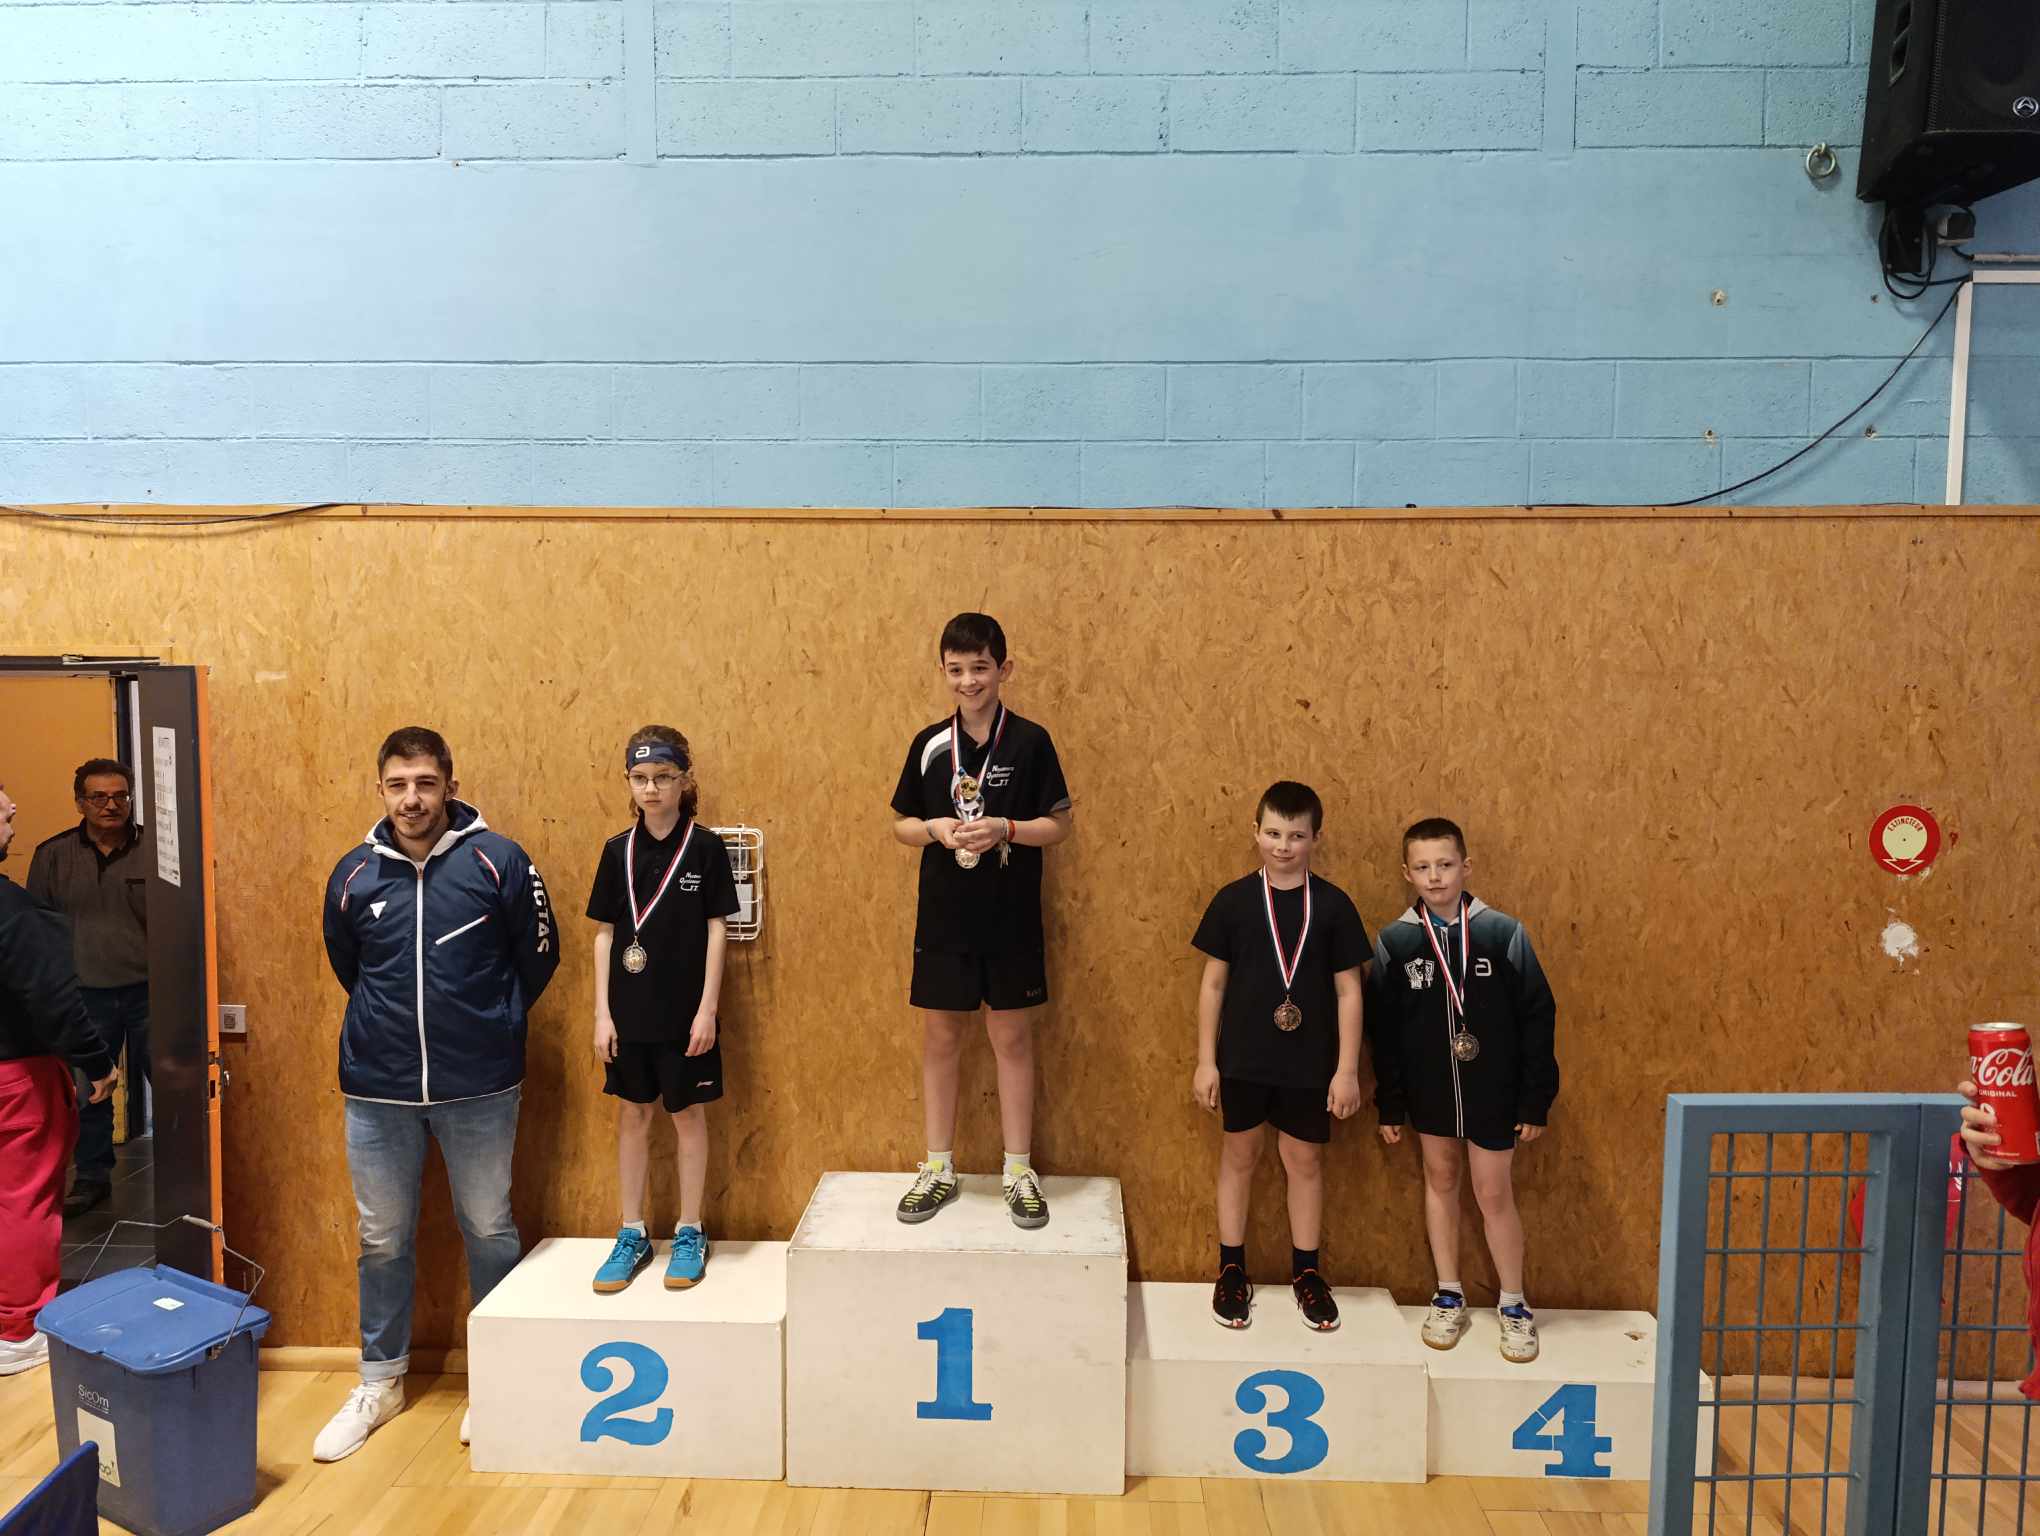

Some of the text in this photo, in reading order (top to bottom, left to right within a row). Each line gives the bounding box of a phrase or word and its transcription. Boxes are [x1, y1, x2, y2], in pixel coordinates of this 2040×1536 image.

[1887, 816, 1923, 832] EXTINCTEUR
[580, 1341, 674, 1446] 2
[917, 1307, 992, 1421] 1
[1234, 1369, 1329, 1474] 3
[1512, 1384, 1612, 1478] 4
